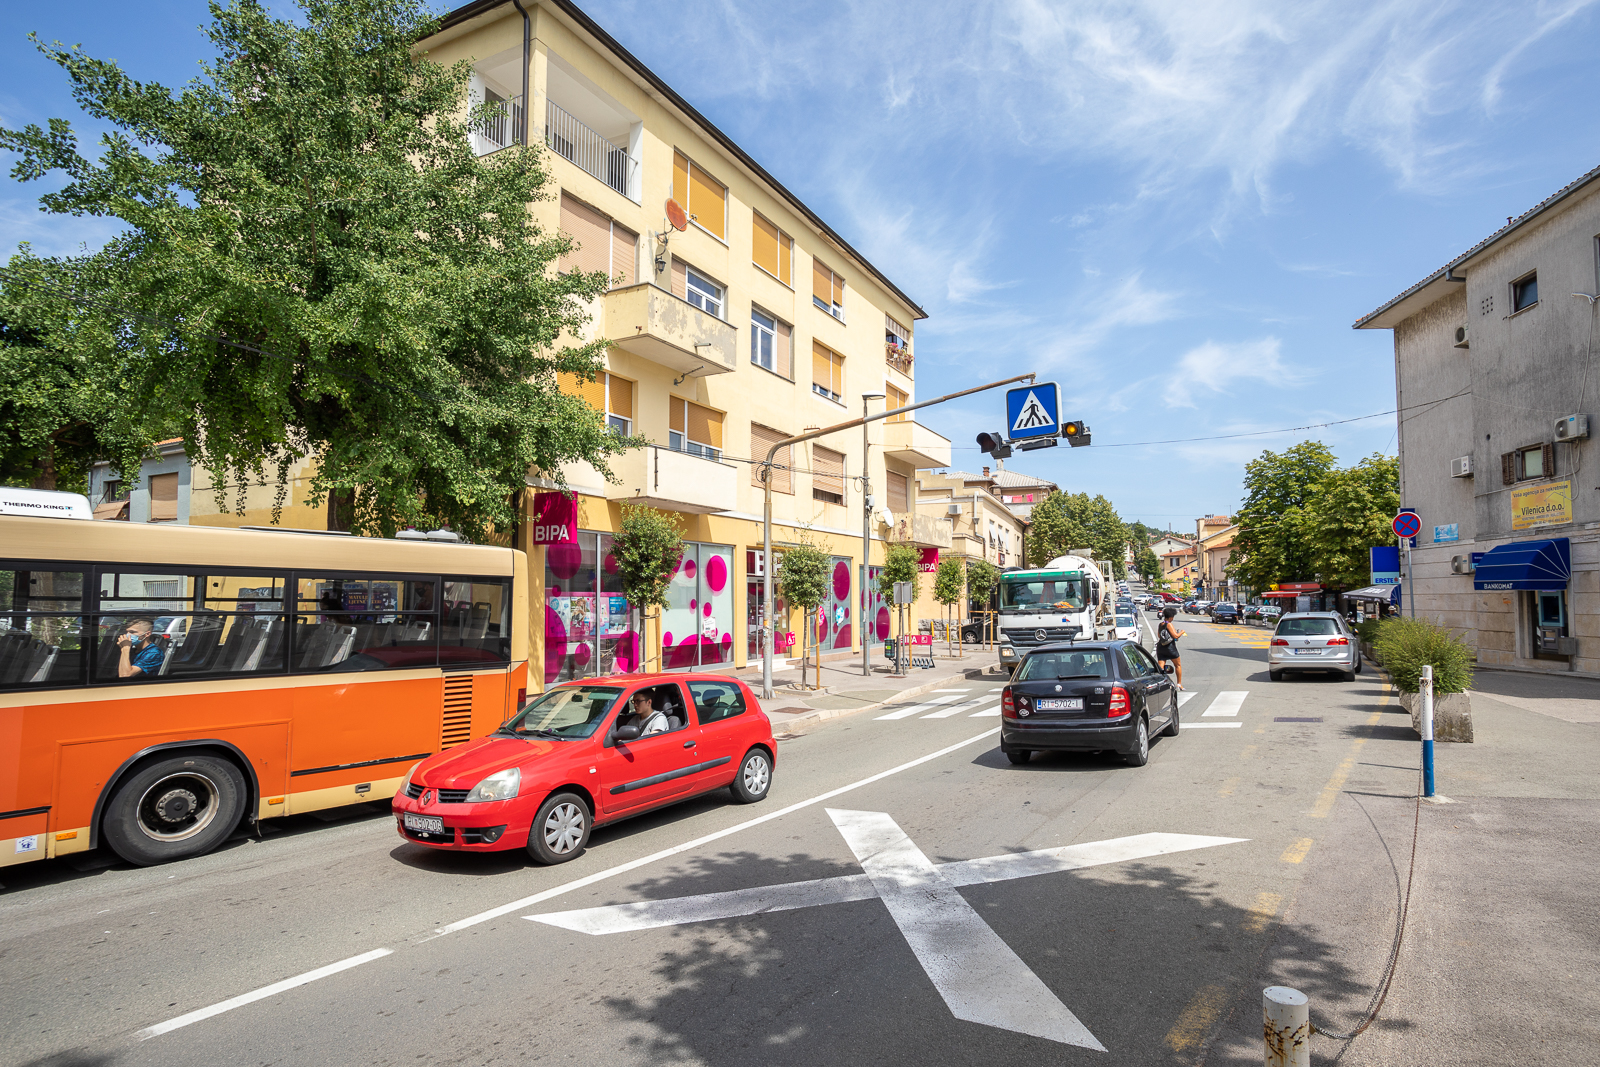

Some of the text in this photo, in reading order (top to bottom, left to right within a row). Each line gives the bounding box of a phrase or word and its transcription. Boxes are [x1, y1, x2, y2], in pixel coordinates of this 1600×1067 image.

[3, 501, 42, 509] THERMO
[1521, 503, 1564, 515] Vilenica d.o.o.
[535, 524, 570, 542] BIPA
[917, 563, 936, 571] BIPA
[1483, 582, 1513, 590] BANKOMAT
[1041, 699, 1050, 708] RI
